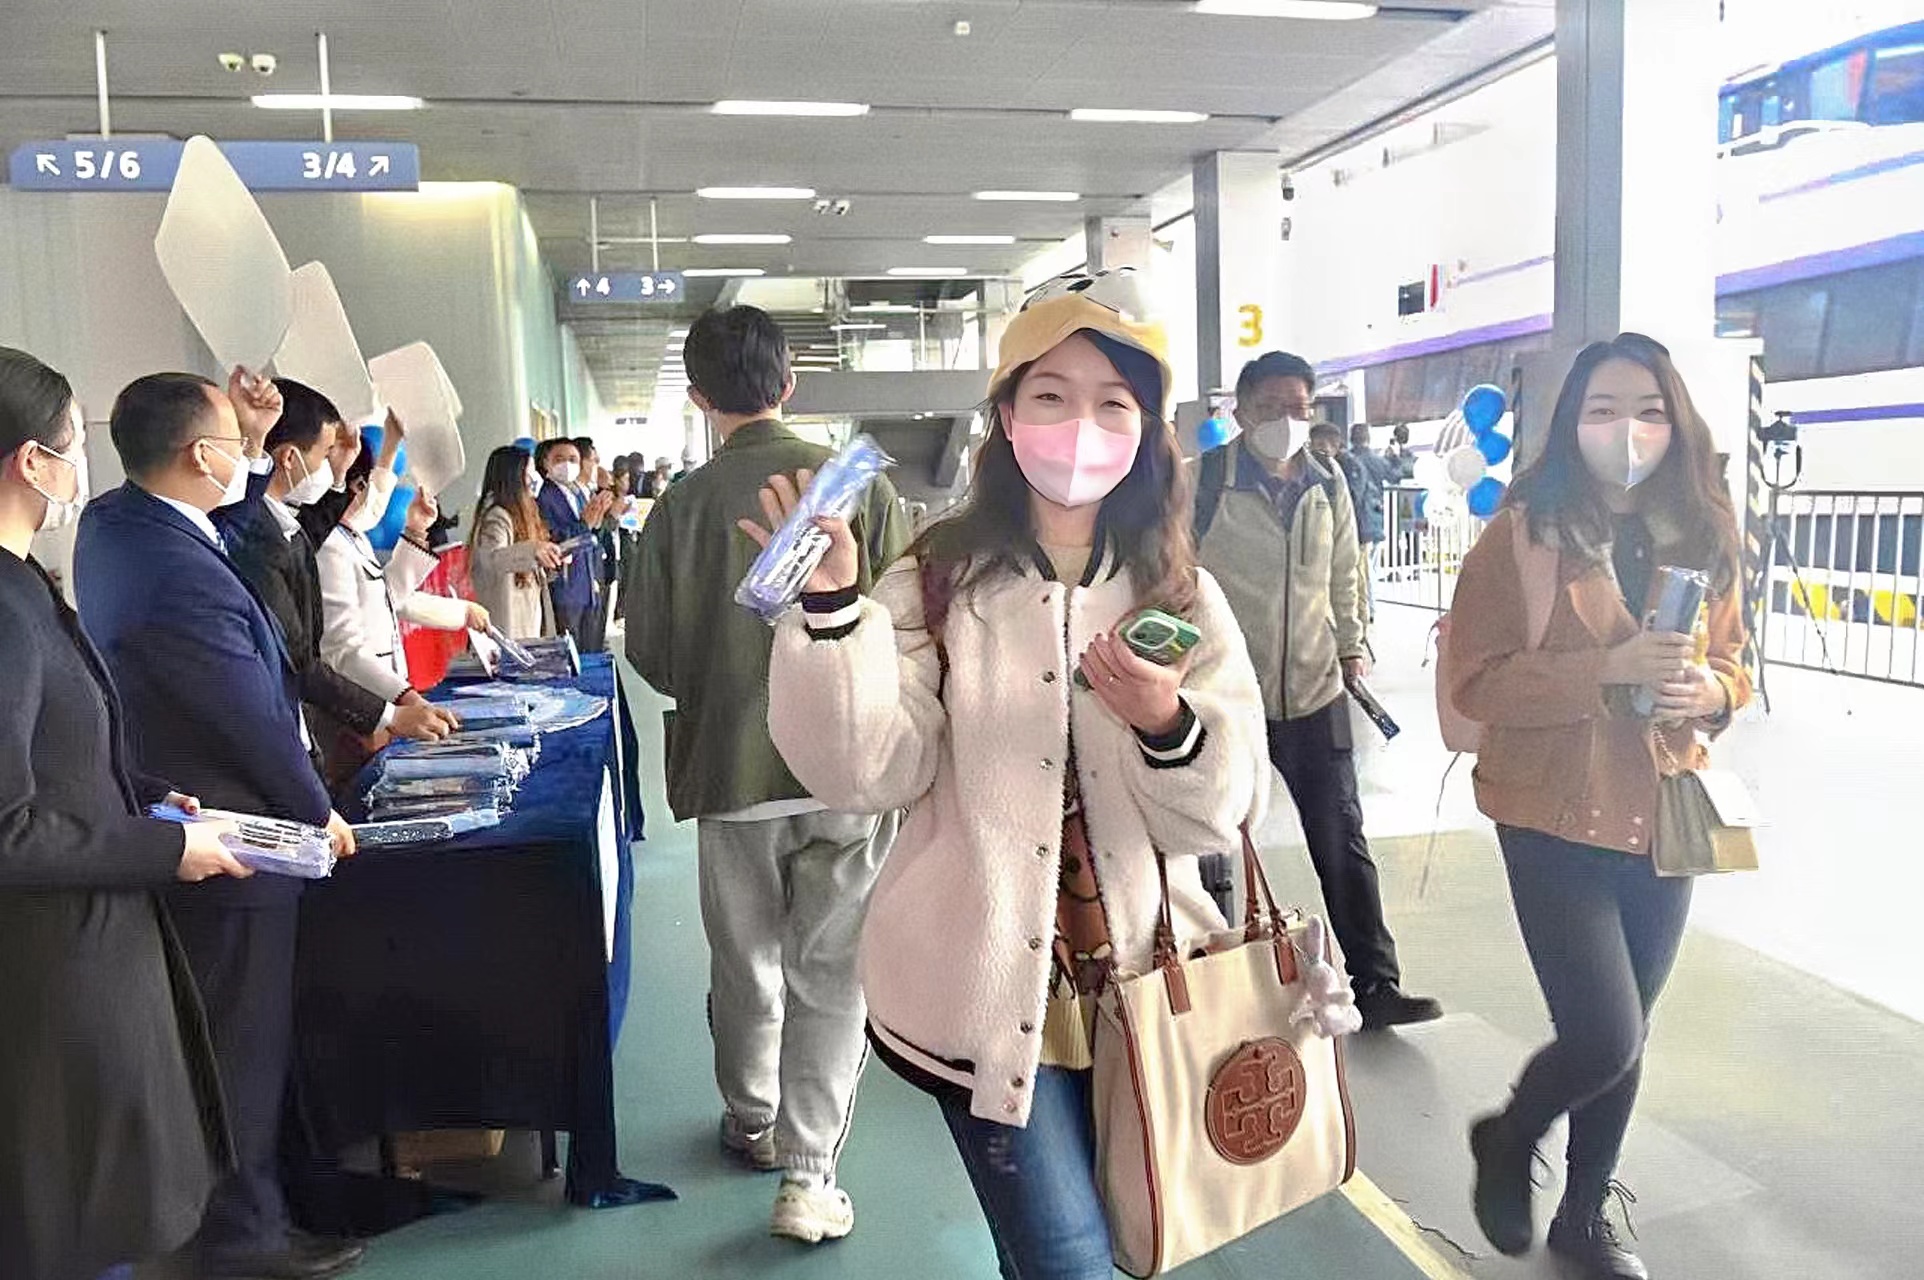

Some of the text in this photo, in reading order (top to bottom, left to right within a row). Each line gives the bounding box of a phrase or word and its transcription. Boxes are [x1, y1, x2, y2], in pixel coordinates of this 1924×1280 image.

[74, 151, 141, 179] 5/6
[303, 151, 357, 179] 3/4
[596, 277, 611, 295] 4
[641, 276, 654, 295] 3
[1238, 304, 1263, 347] 3
